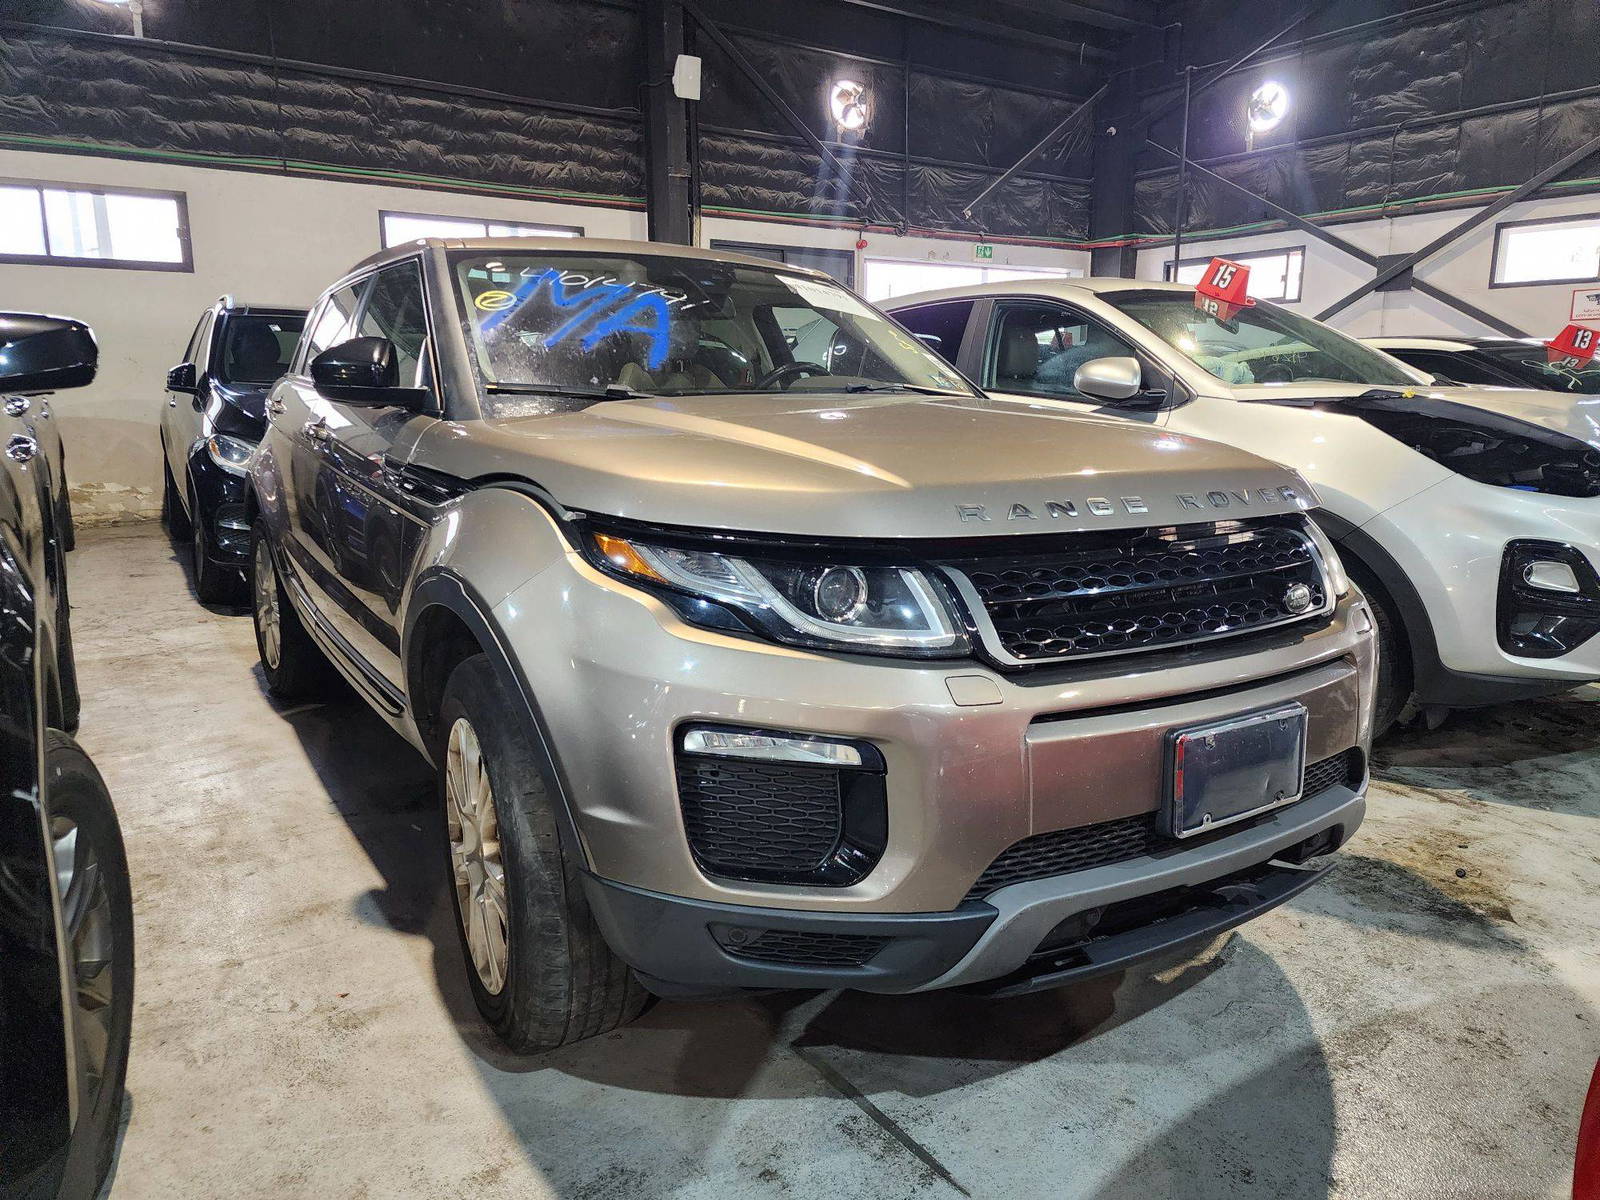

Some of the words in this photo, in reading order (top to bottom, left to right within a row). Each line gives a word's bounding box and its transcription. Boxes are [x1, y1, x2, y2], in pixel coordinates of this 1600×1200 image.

[1212, 264, 1237, 289] 15
[1574, 330, 1593, 349] 13
[956, 496, 1148, 522] RANGE
[1176, 485, 1297, 510] ROVER
